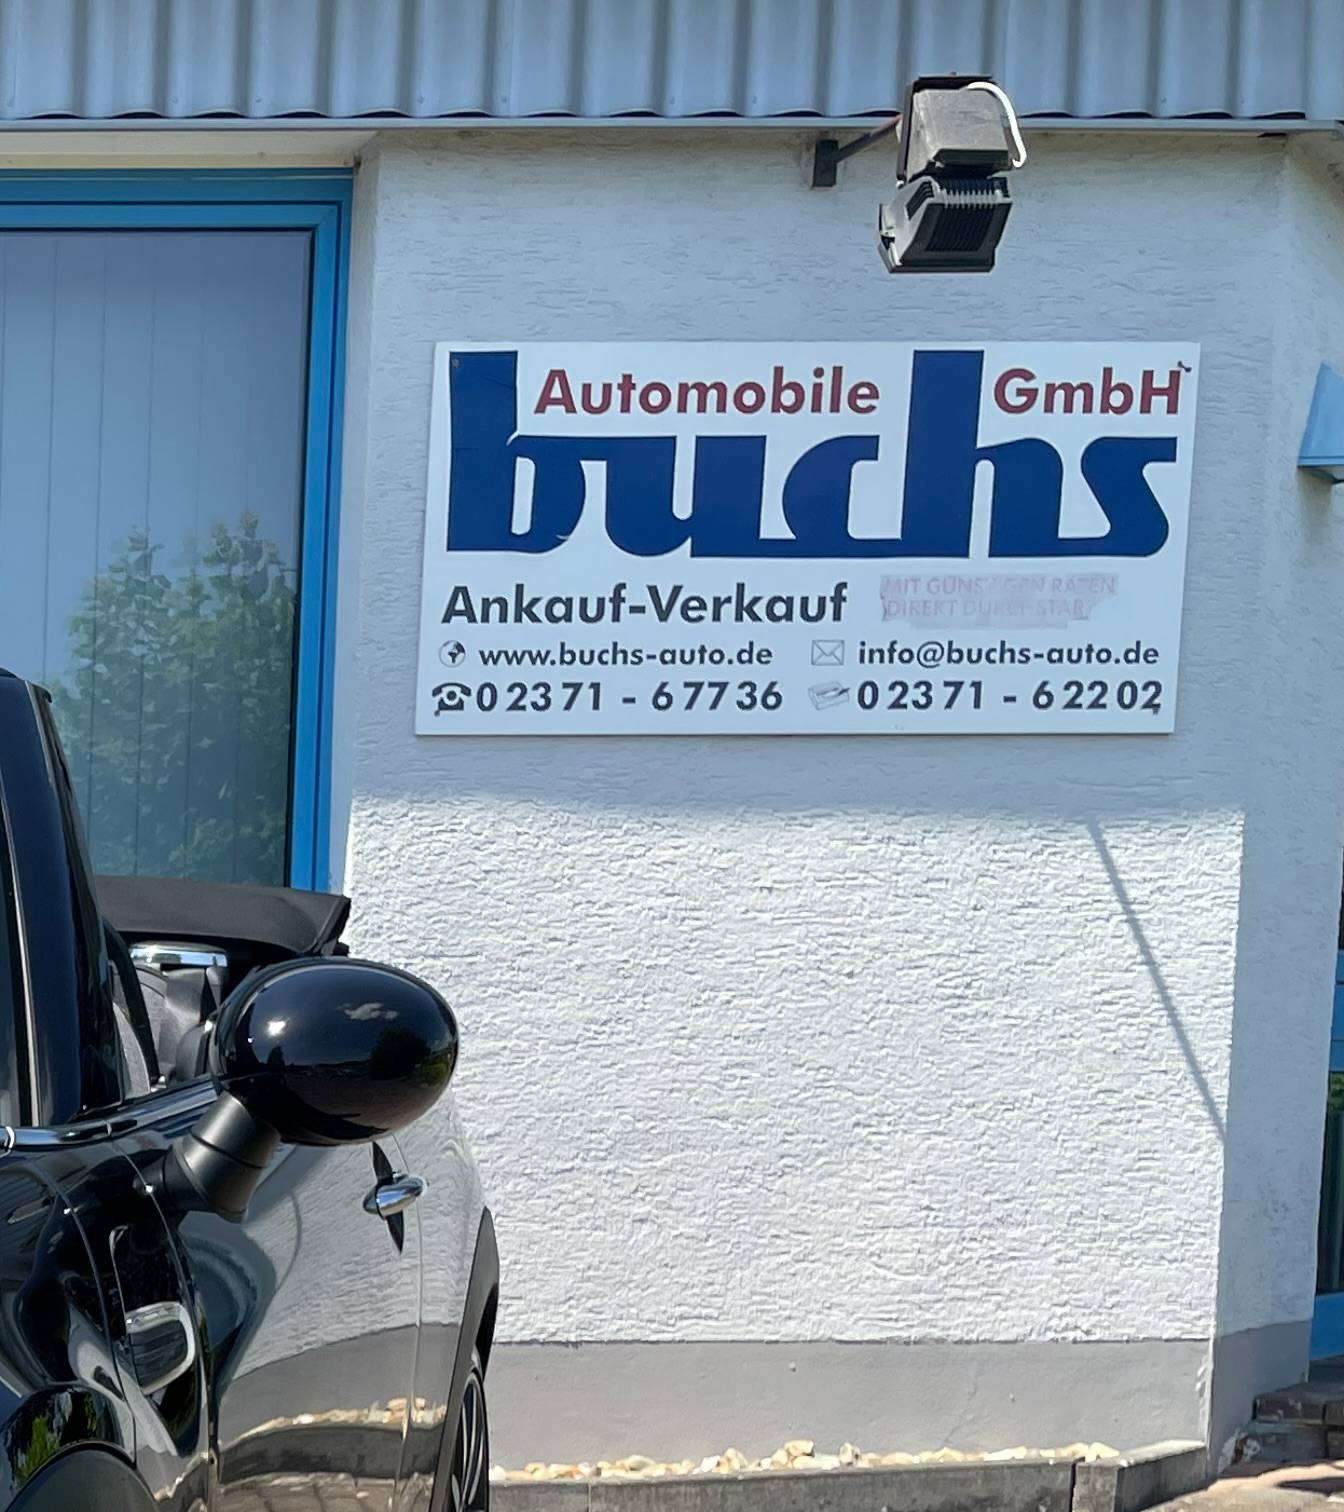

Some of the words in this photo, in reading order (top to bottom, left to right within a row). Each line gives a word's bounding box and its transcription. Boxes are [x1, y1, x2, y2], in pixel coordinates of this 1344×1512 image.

[534, 366, 880, 415] Automobile
[994, 368, 1181, 416] GmbH
[447, 349, 1178, 558] buchs
[441, 582, 848, 624] Ankauf-Verkauf
[479, 641, 773, 666] www.buchs-auto.de
[859, 640, 1159, 668] info@buchs-auto.de
[476, 682, 601, 712] 02371
[651, 681, 784, 712] 67736
[857, 681, 983, 710] 02371
[1032, 680, 1162, 710] 62202
